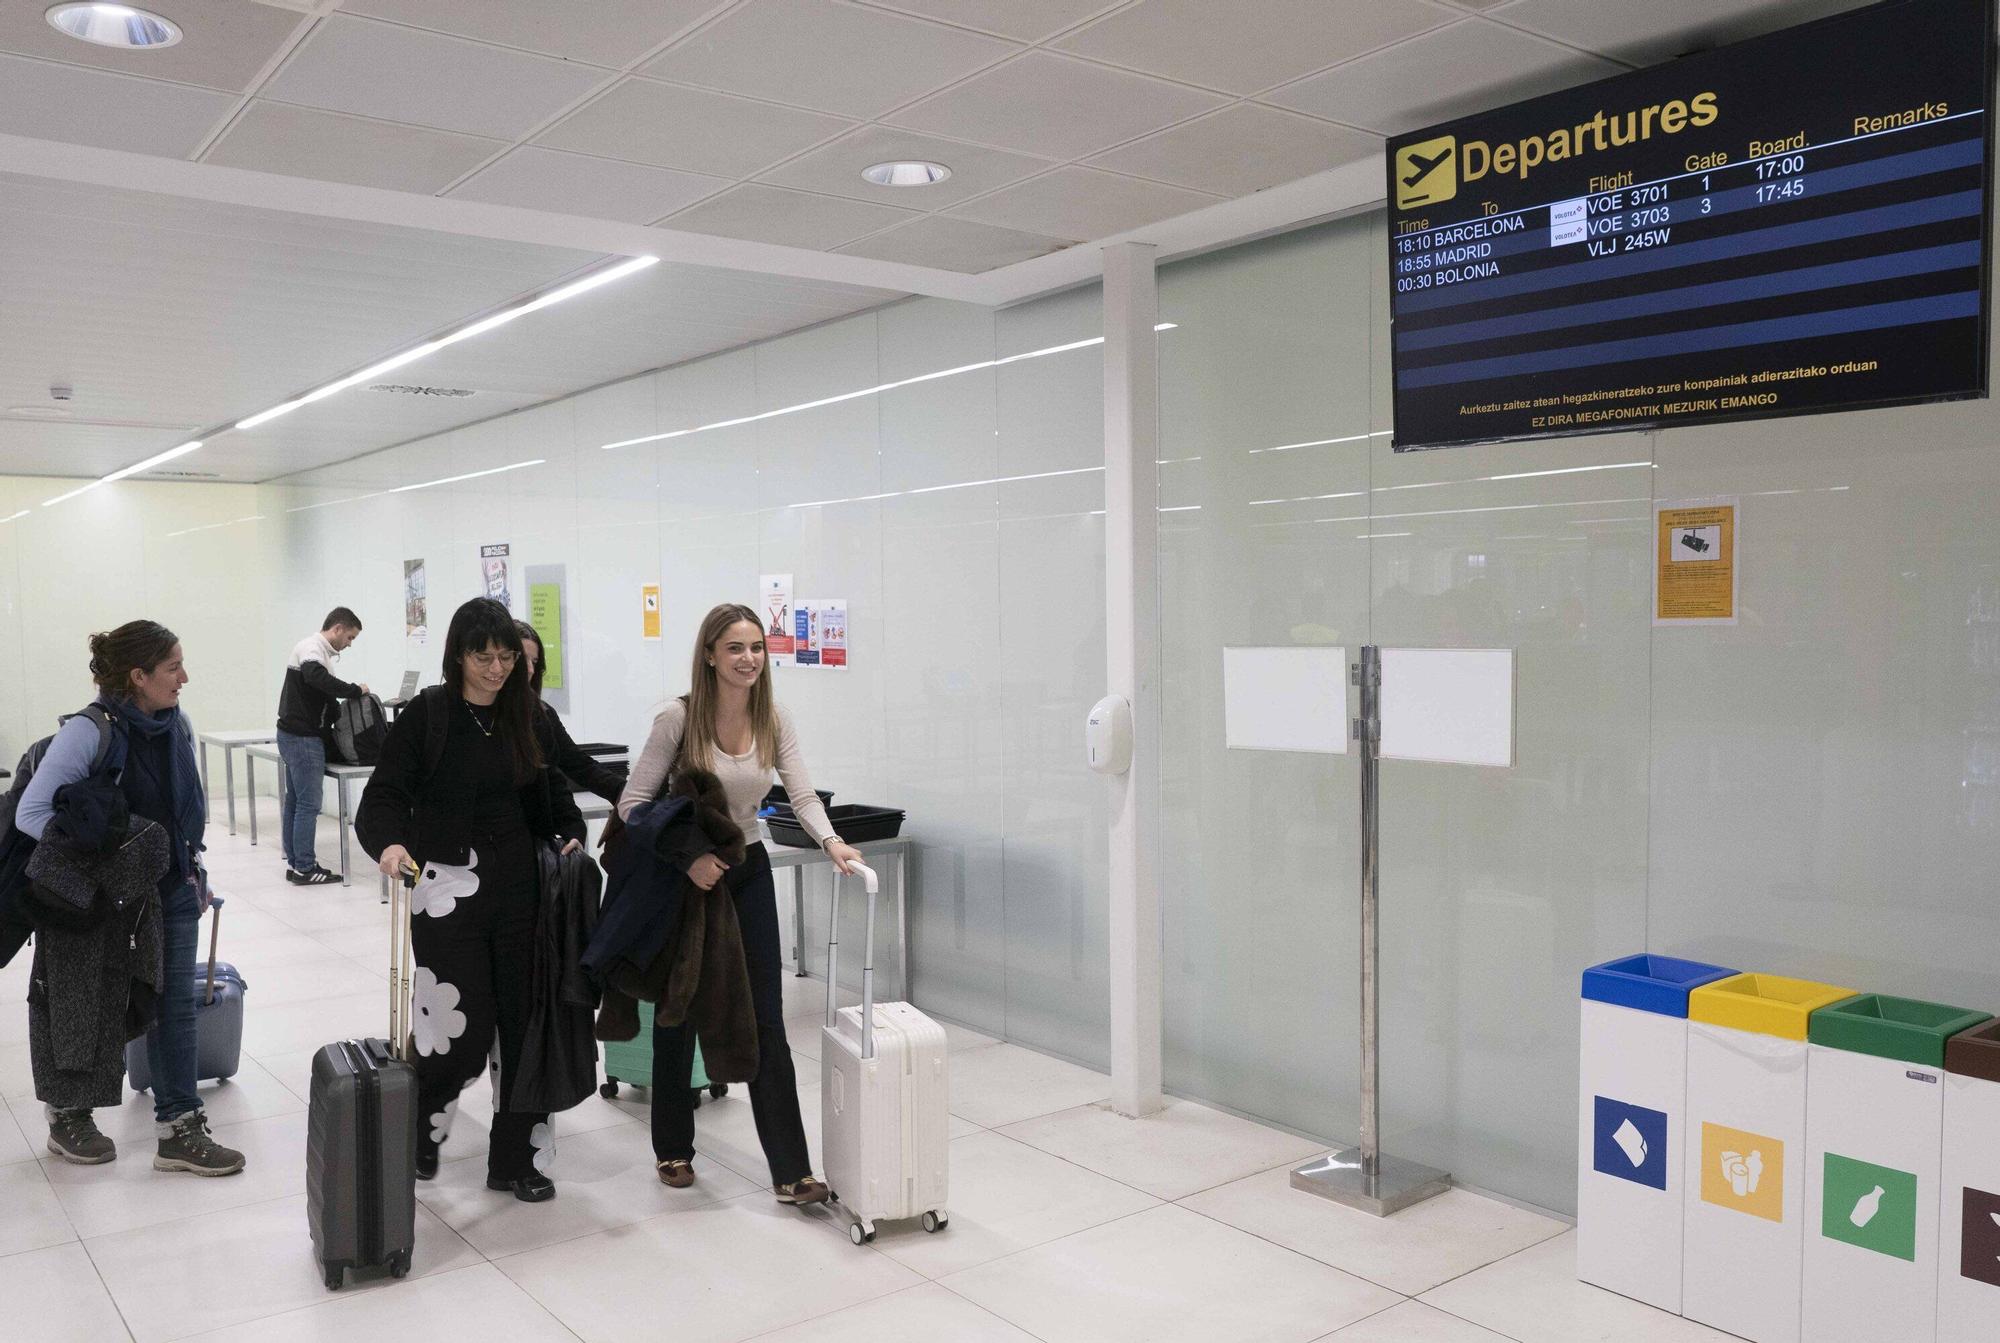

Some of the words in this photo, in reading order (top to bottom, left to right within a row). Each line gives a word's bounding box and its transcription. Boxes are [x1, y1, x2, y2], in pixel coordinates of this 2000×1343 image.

[1397, 219, 1429, 234] Time
[1481, 201, 1499, 216] To
[1589, 170, 1633, 194] Flight
[1685, 150, 1728, 172] Gate
[1749, 131, 1810, 159] Board.
[1854, 101, 1948, 136] Remarks
[1463, 91, 1719, 182] Departures
[1397, 235, 1430, 254] 18:10
[1435, 215, 1525, 247] BARCELONA
[1587, 194, 1622, 215] VOE
[1631, 184, 1668, 206] 3701
[1702, 175, 1709, 191] 1
[1756, 155, 1804, 180] 17:00
[1398, 254, 1431, 273] 18:55
[1435, 243, 1491, 266] MADRID
[1587, 216, 1622, 236] VOE
[1631, 207, 1669, 228] 3703
[1701, 198, 1711, 214] 3
[1756, 179, 1804, 203] 17:45
[1397, 274, 1432, 292] 00:30
[1436, 261, 1500, 285] BOLONIA
[1588, 238, 1616, 257] VLJ
[1625, 228, 1671, 251] 245W
[1459, 402, 1501, 416] Aurkeztu
[1503, 399, 1531, 411] zaitez
[1533, 396, 1560, 407] atean
[1562, 385, 1654, 406] hegazkineratzeko
[1657, 383, 1681, 394] zure
[1684, 373, 1748, 391] konpainiak
[1751, 365, 1827, 383] adierazitako
[1830, 360, 1878, 375] orduan
[1532, 416, 1545, 428] EZ
[1547, 414, 1573, 426] DIRA
[1576, 405, 1660, 424] MEGAFONIATIK
[1663, 399, 1717, 415] MEZURIK
[1721, 392, 1778, 409] EMANGO
